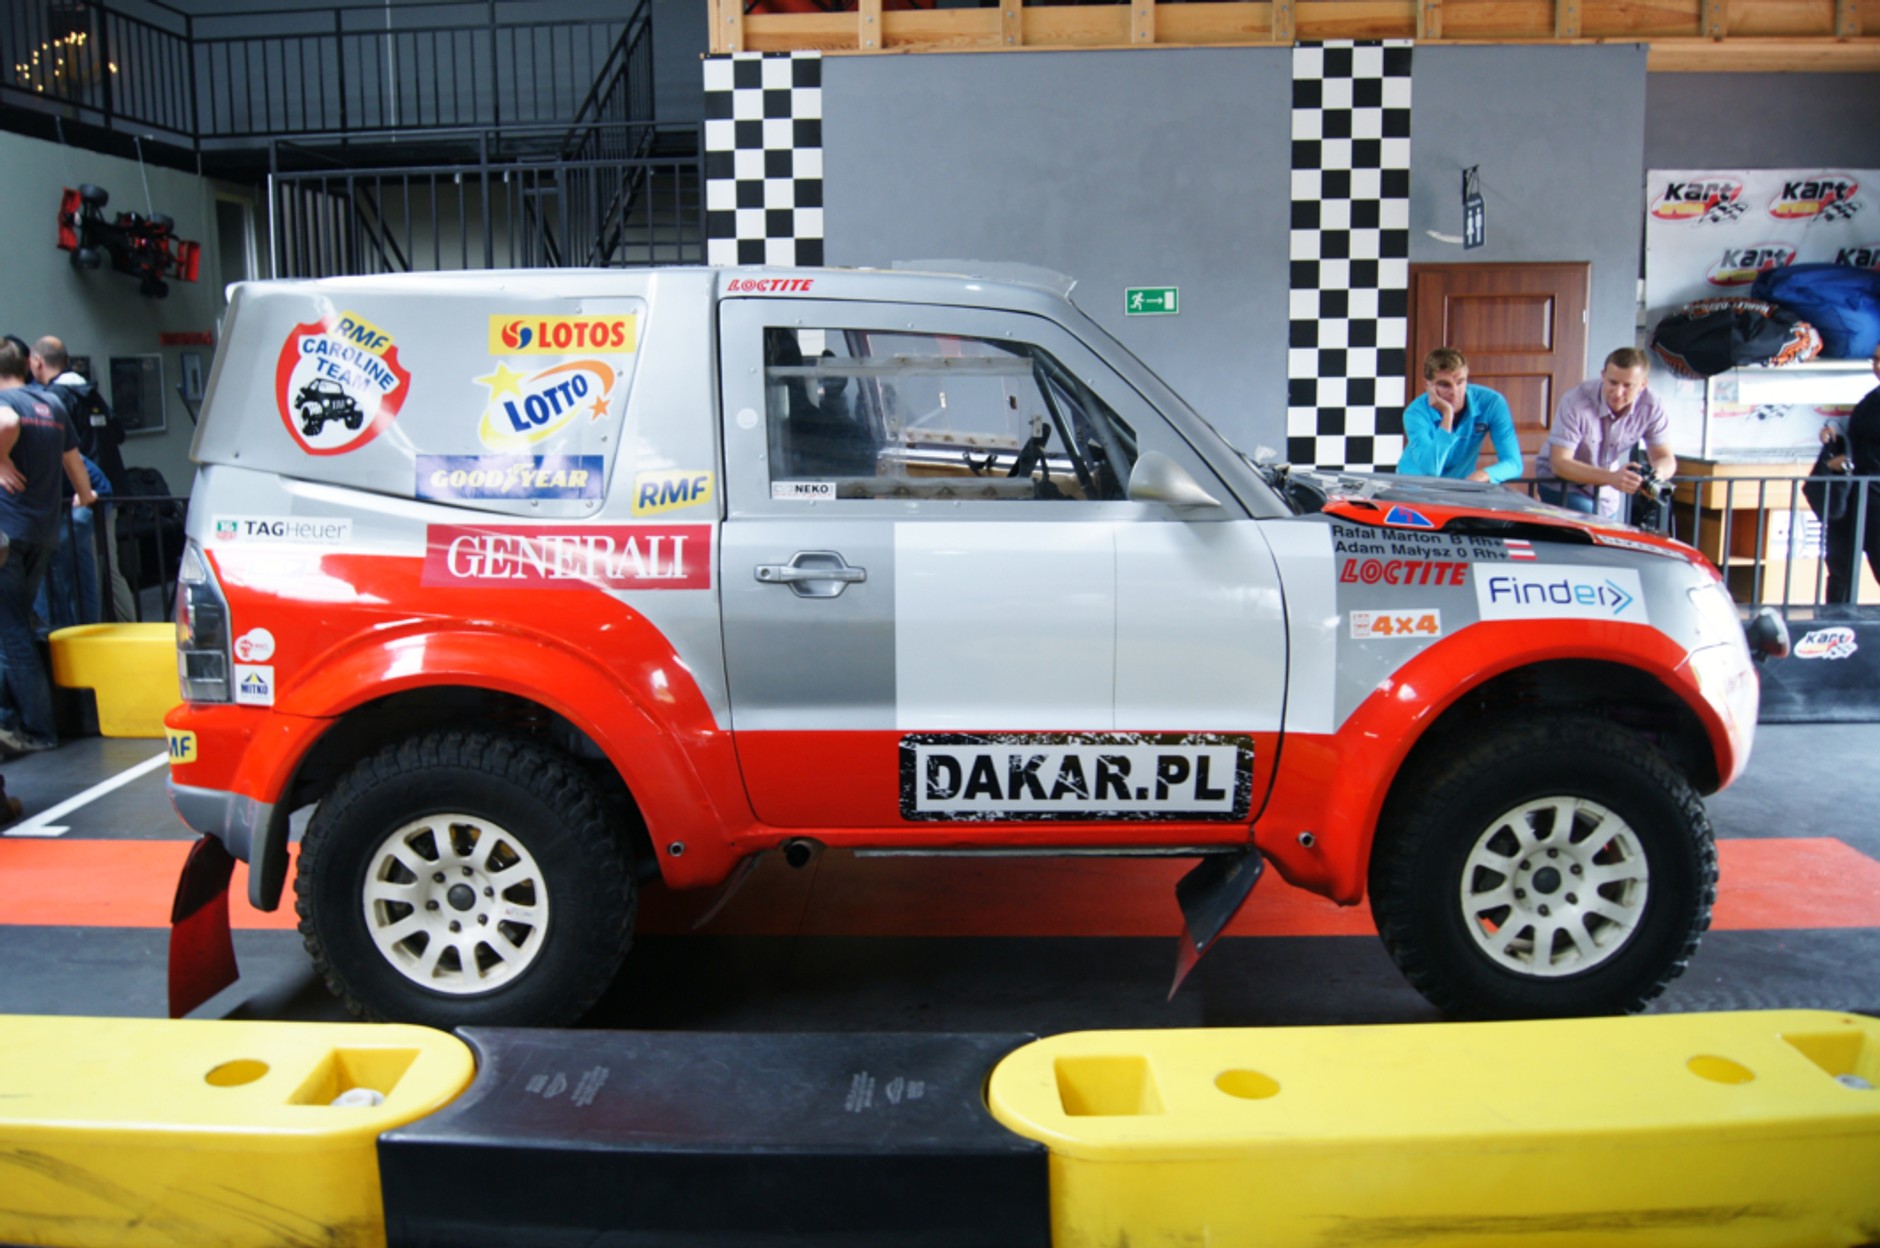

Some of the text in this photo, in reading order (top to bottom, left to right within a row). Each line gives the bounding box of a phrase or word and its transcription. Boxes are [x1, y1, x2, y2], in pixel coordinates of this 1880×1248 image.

[1664, 182, 1733, 201] Kart
[1782, 181, 1847, 201] Kart
[1720, 248, 1786, 268] Kart
[727, 279, 814, 291] LOCTITE
[335, 317, 389, 349] RMF
[538, 321, 626, 349] LOTOS
[302, 338, 395, 391] CAROLINE
[316, 357, 371, 392] TEAM
[503, 373, 589, 432] LOTTO
[638, 475, 708, 509] RMF
[795, 484, 829, 493] NEKO
[1336, 540, 1385, 554] Adam
[1381, 528, 1441, 544] Marton
[446, 534, 689, 580] GENERALI
[1339, 559, 1468, 586] LOCTITE
[1371, 613, 1438, 635] 4x4
[168, 736, 191, 757] MF
[926, 755, 1226, 801] DAKAR.PL
